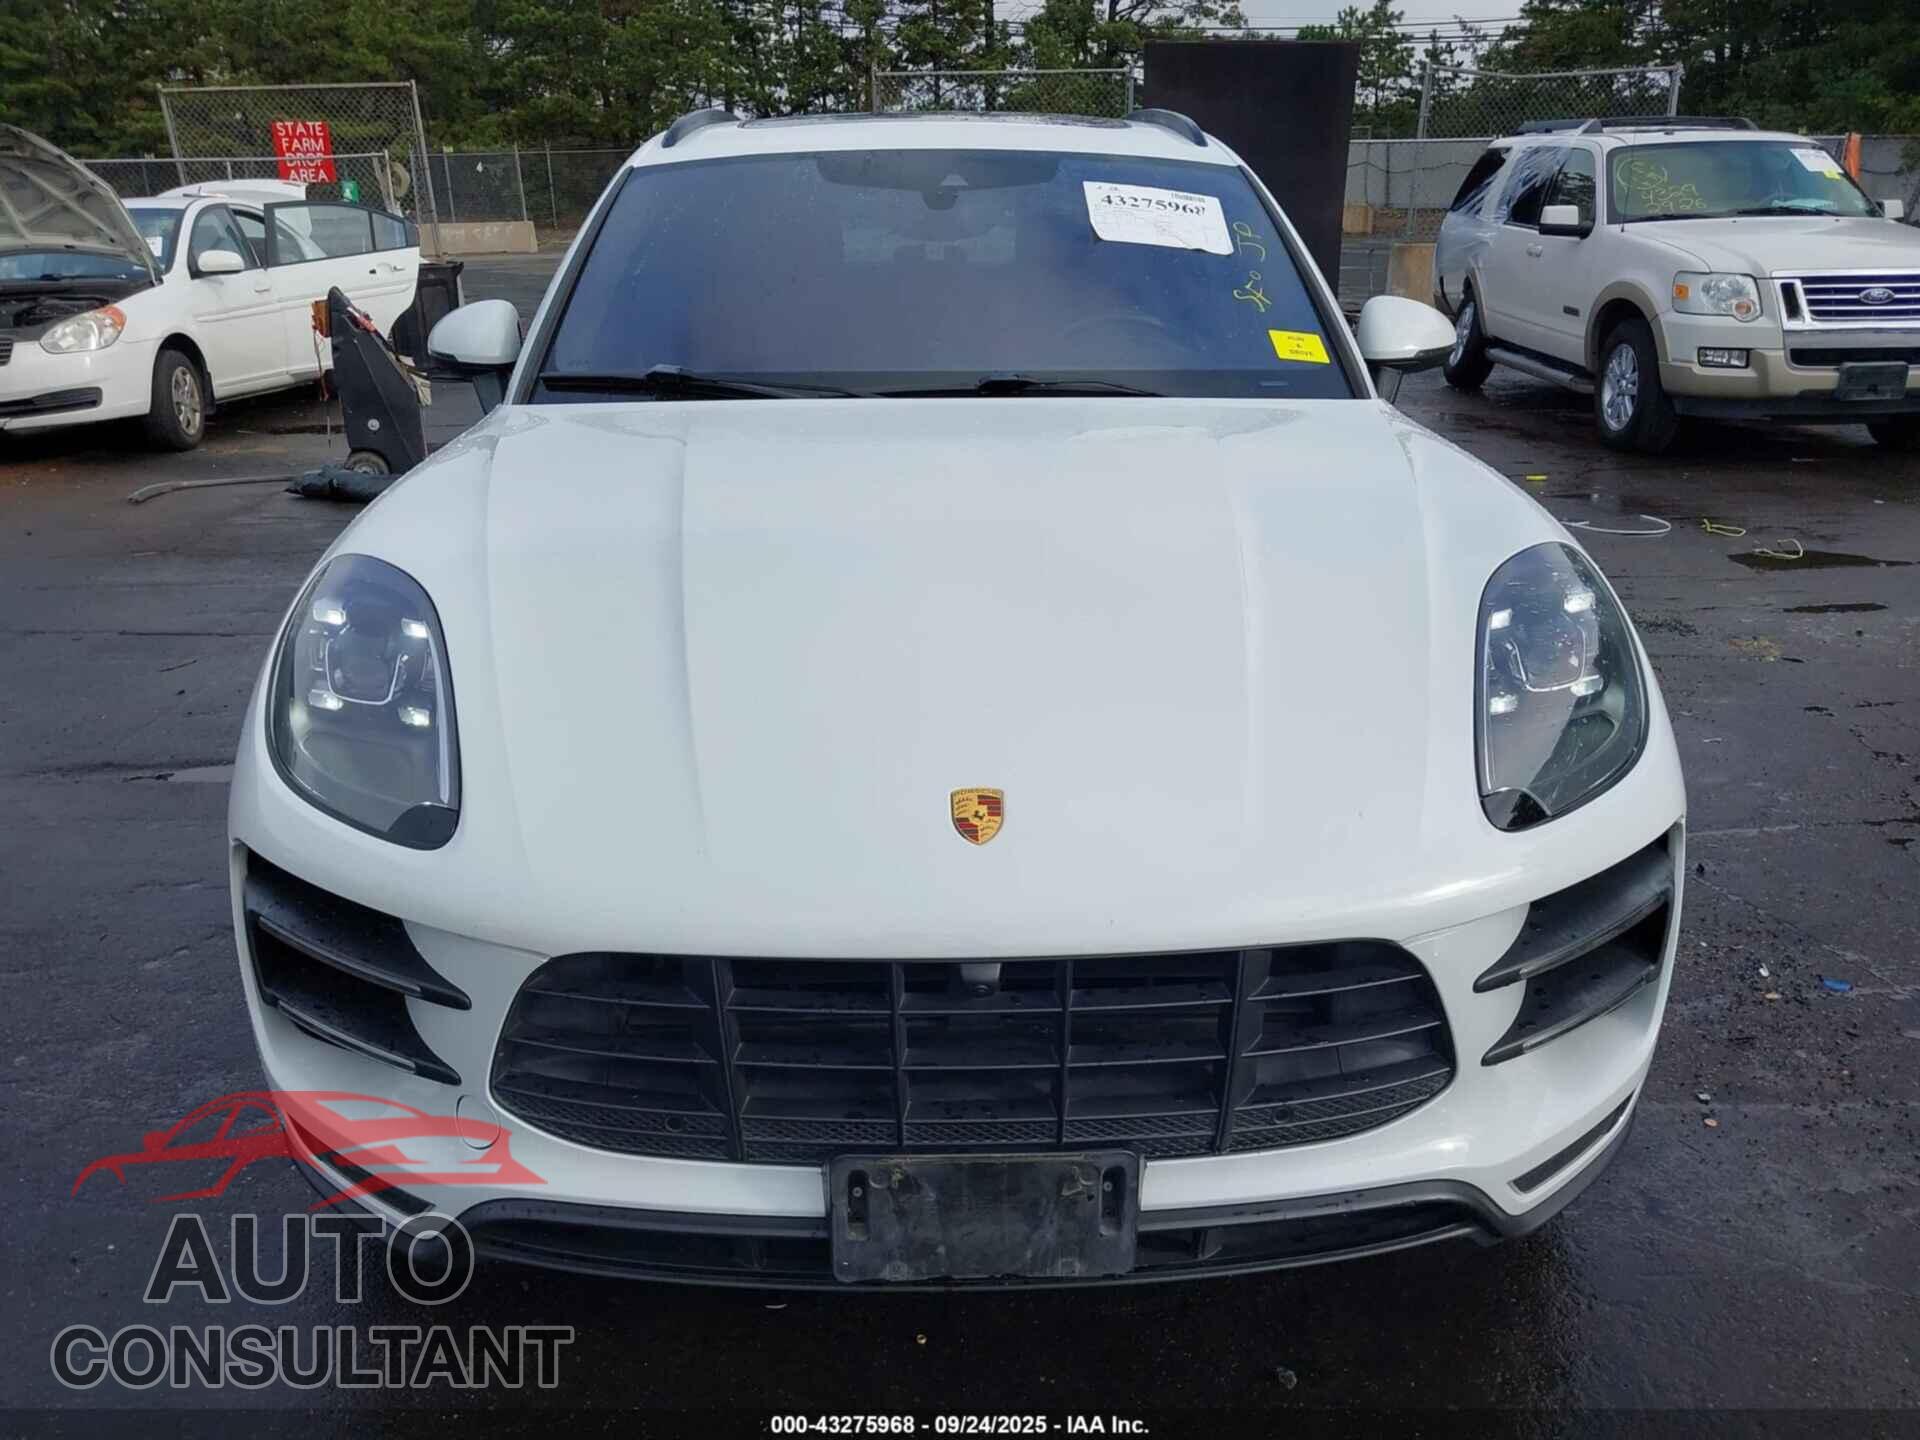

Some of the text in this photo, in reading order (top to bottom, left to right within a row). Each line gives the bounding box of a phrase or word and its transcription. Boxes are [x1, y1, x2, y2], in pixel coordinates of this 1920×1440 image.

[276, 121, 324, 136] STATE
[282, 138, 325, 152] FARM
[285, 153, 325, 167] DROP
[288, 169, 329, 182] AREA
